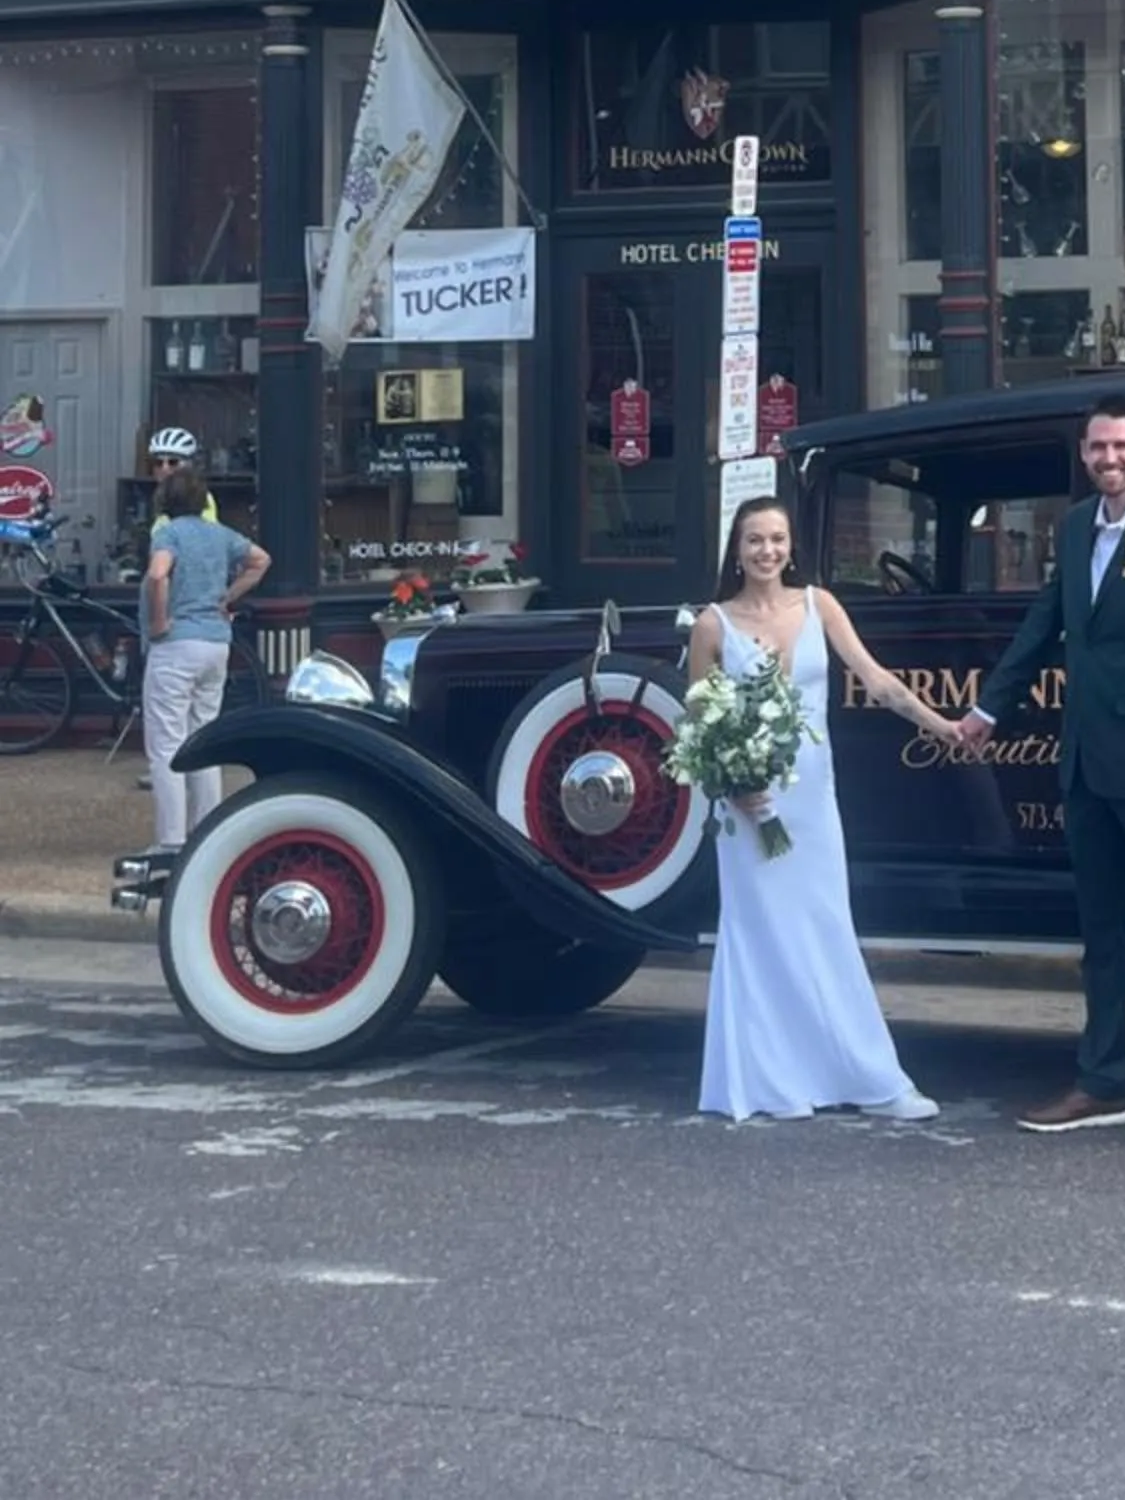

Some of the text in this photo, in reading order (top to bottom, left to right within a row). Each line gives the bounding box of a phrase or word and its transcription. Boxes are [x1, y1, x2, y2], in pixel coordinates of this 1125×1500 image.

[610, 146, 717, 170] HERMANN
[719, 138, 808, 164] COWN
[621, 244, 681, 264] HOTEL
[349, 542, 386, 558] HOTEL
